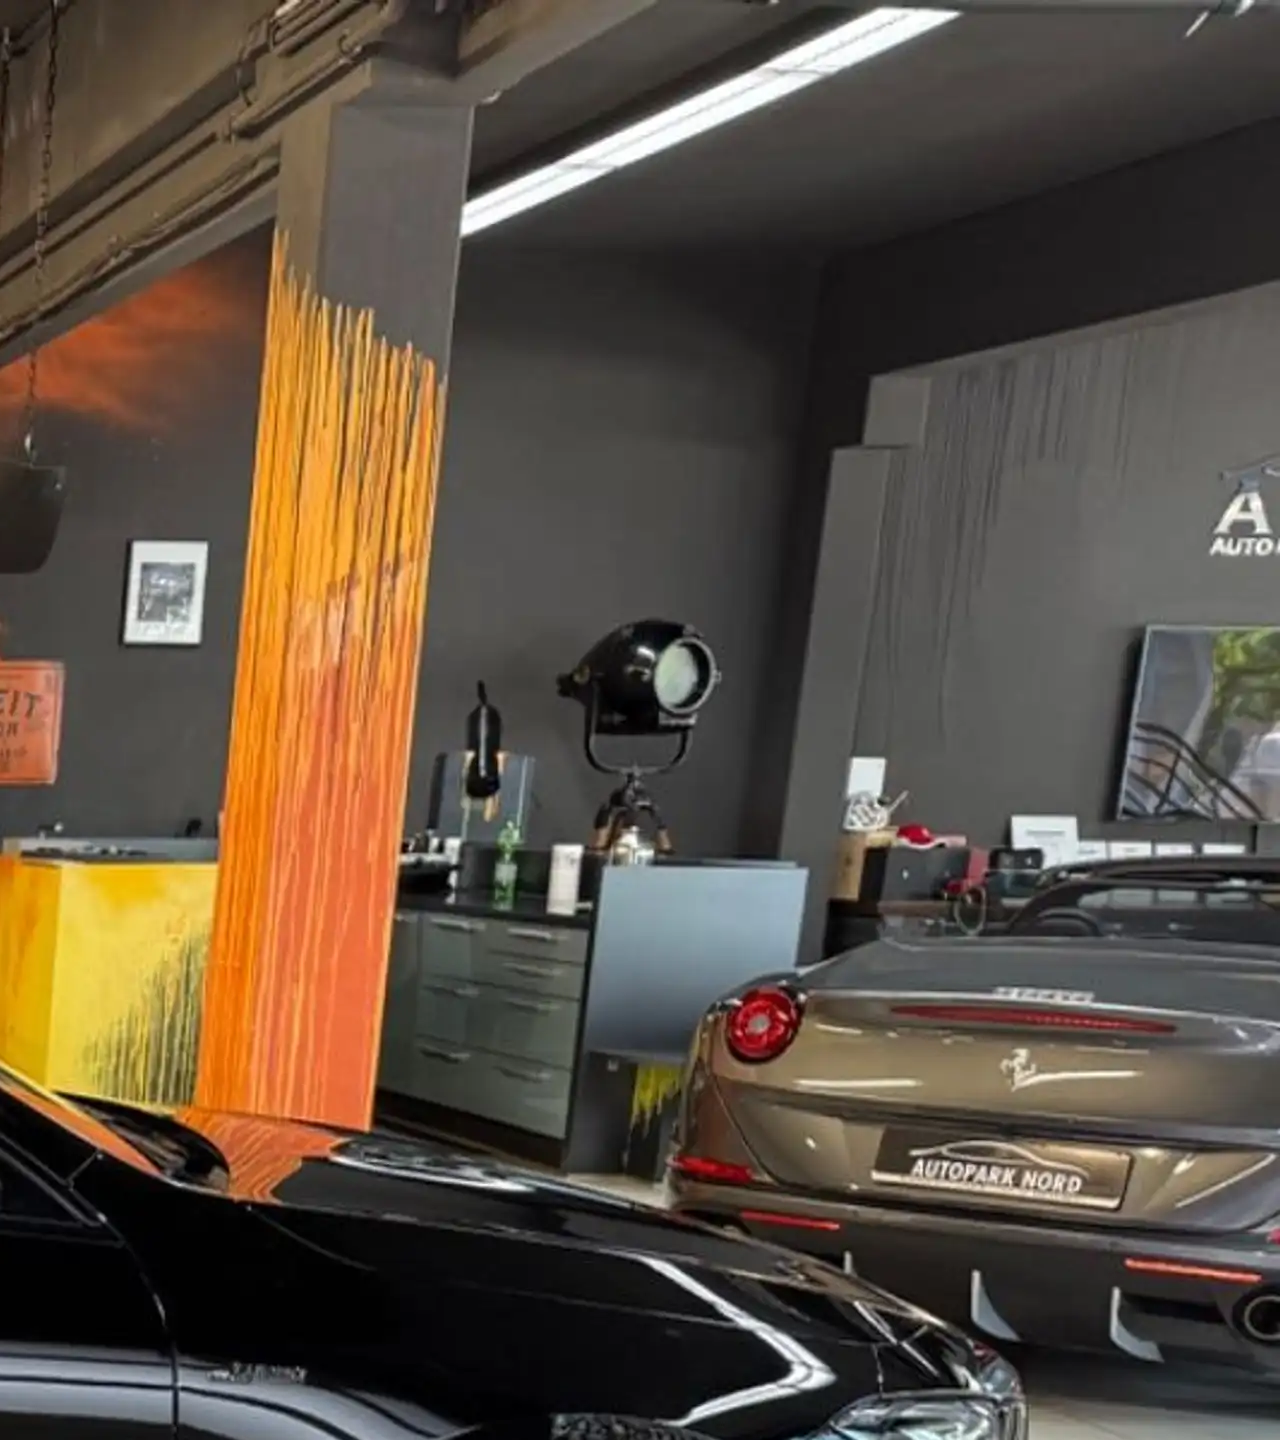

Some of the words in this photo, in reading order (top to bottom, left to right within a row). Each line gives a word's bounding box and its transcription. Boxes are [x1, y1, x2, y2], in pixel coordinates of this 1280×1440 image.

[1209, 536, 1280, 557] AUTO
[911, 1158, 1017, 1188] AUTOPARK
[1020, 1169, 1083, 1194] NORD
